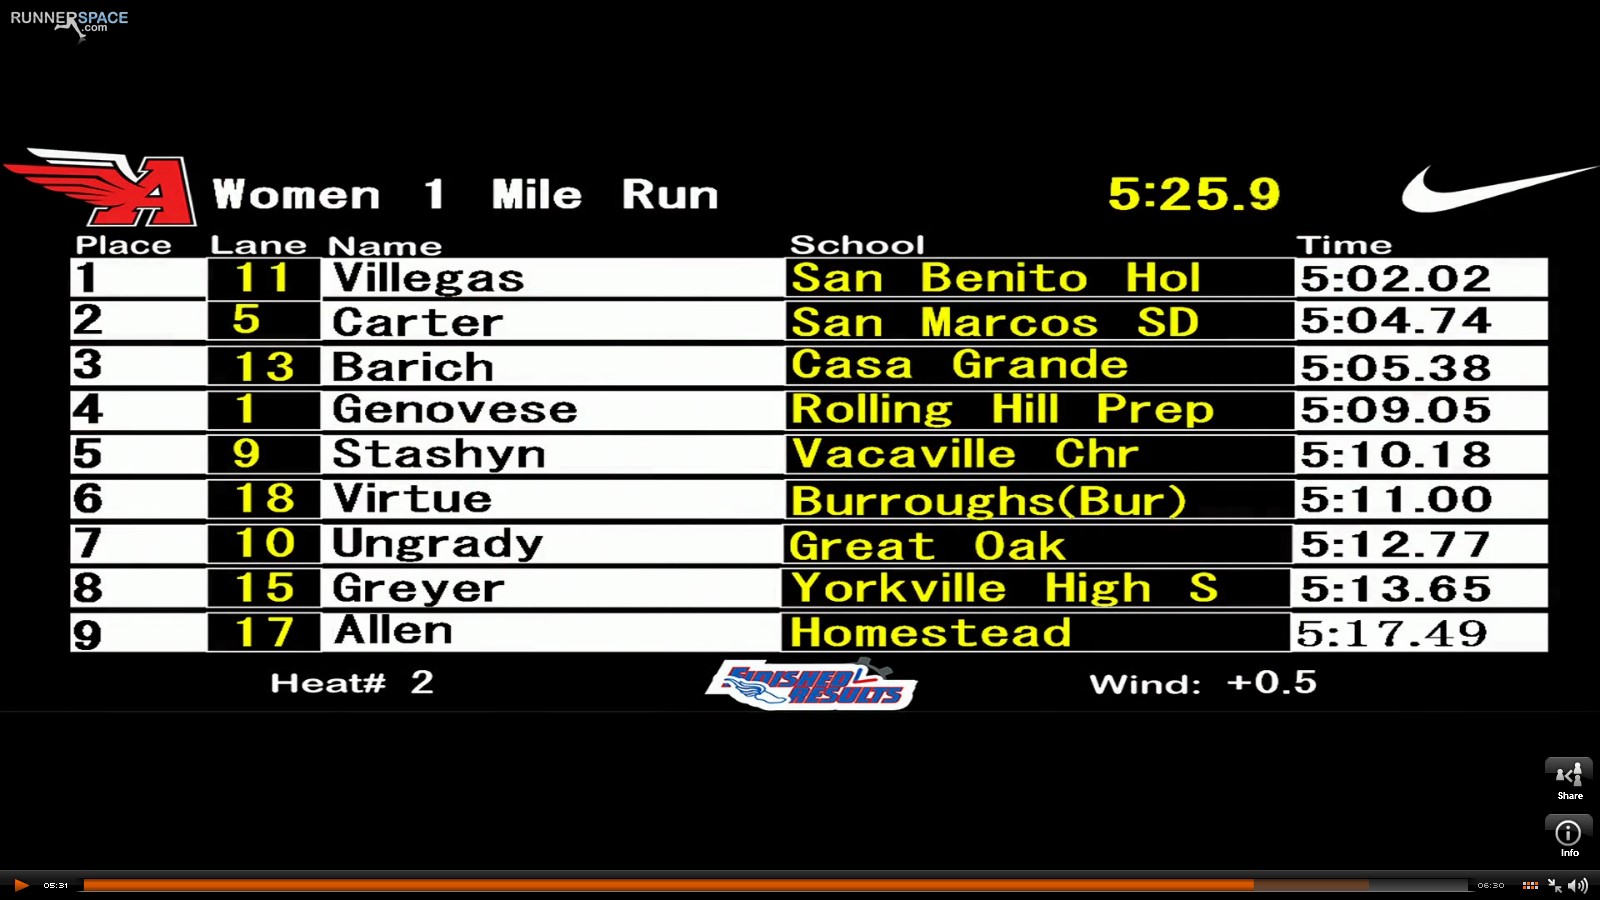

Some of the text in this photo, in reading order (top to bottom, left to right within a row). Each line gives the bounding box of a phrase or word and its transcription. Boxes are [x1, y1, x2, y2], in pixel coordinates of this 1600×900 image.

[212, 179, 718, 208] Women 1 Mile Run
[1108, 177, 1280, 210] 5:25.9
[76, 235, 172, 254] Place
[211, 235, 307, 254] Lane
[328, 237, 442, 256] Name
[790, 235, 924, 254] School
[1296, 235, 1392, 254] Time
[76, 262, 94, 292] 1
[236, 262, 286, 291] 11
[333, 262, 524, 296] Villegas
[792, 262, 1200, 291] San Benito Hol
[1301, 265, 1491, 291] 5:02.02
[73, 304, 103, 334] 2
[233, 304, 260, 333] 5
[333, 307, 504, 336] Carter
[792, 307, 1199, 336] San Marcos SD
[1301, 307, 1492, 333] 5:04.74
[73, 349, 102, 378] 3
[236, 352, 294, 381] 13
[333, 352, 493, 381] Barich
[792, 349, 1128, 378] Casa Grande
[1301, 355, 1491, 381] 5:05.38
[72, 393, 104, 423] 4
[236, 394, 252, 423] 1
[333, 393, 578, 423] Genovese
[792, 393, 1214, 428] Rolling Hill Prep
[1301, 397, 1491, 423] 5:09.05
[73, 438, 102, 468] 5
[233, 438, 260, 467] 9
[333, 438, 545, 472] Stashyn
[792, 438, 1139, 467] Vacaville Chr
[1301, 441, 1491, 467] 5:10.18
[73, 483, 103, 513] 6
[236, 483, 295, 512] 18
[333, 483, 492, 512] Virtue
[792, 485, 1186, 518] Burroughs(Bur)
[1301, 486, 1492, 512] 5:11.00
[74, 528, 102, 557] 7
[236, 528, 295, 557] 10
[333, 528, 544, 562] Ungrady
[789, 531, 1067, 560] Great Oak
[1301, 531, 1490, 557] 5:12.77
[73, 572, 103, 602] 8
[236, 572, 294, 602] 15
[333, 572, 505, 607] Greyer
[792, 572, 1218, 607] Yorkville High S
[1301, 575, 1491, 602] 5:13.65
[73, 620, 102, 650] 9
[236, 617, 294, 646] 17
[334, 614, 452, 643] Allen
[791, 617, 1071, 646] Homestead
[1297, 620, 1487, 646] 5:17.49
[271, 670, 434, 693] Heat# 2
[789, 686, 903, 704] RESULTS
[1089, 670, 1317, 694] Wind: +0.5
[1557, 791, 1584, 800] Share
[1560, 848, 1580, 857] Info
